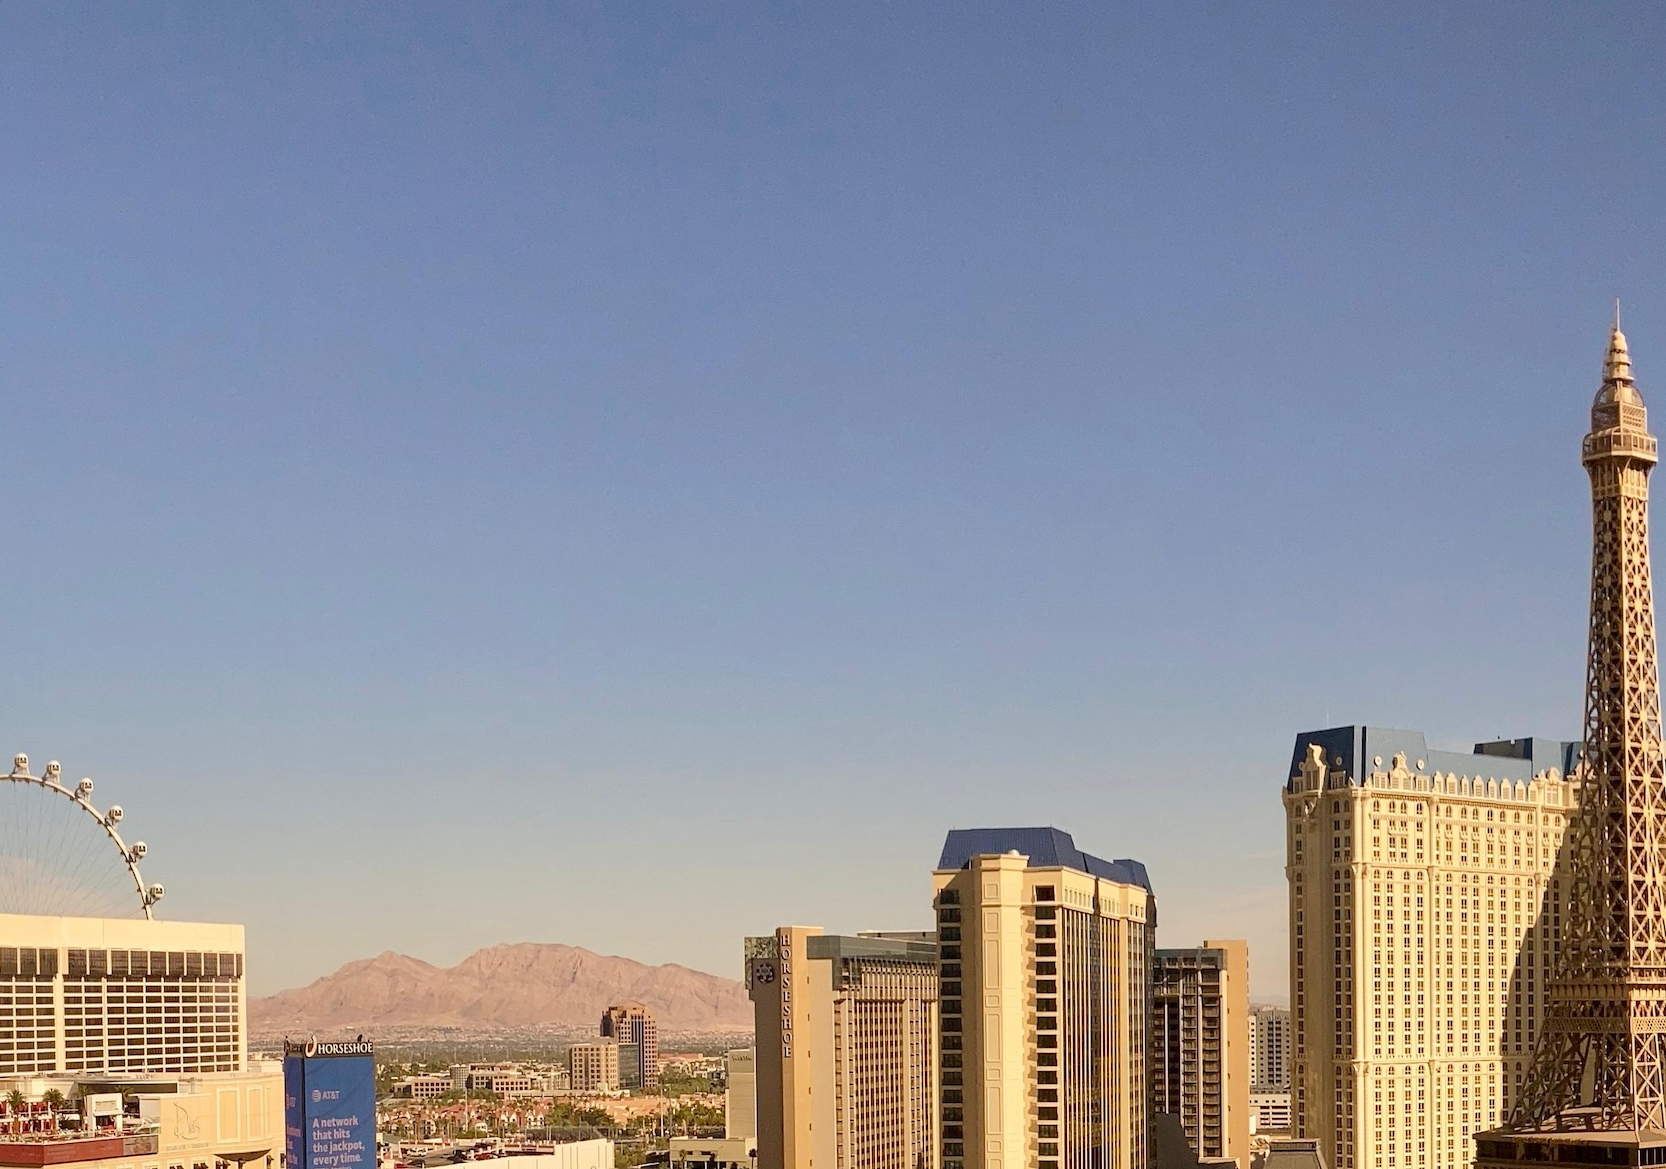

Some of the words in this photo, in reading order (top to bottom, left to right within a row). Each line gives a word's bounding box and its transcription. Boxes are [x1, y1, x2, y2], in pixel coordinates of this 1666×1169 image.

[781, 934, 793, 1058] HORSESHOE
[318, 1042, 373, 1055] HORSESHOE
[322, 1090, 340, 1100] AT&T
[313, 1118, 320, 1128] A
[321, 1115, 359, 1128] network
[313, 1130, 332, 1141] that
[333, 1128, 351, 1139] hits
[313, 1142, 329, 1153] the
[329, 1140, 366, 1155] jackpot,
[314, 1155, 339, 1167] every
[340, 1152, 363, 1164] time.
